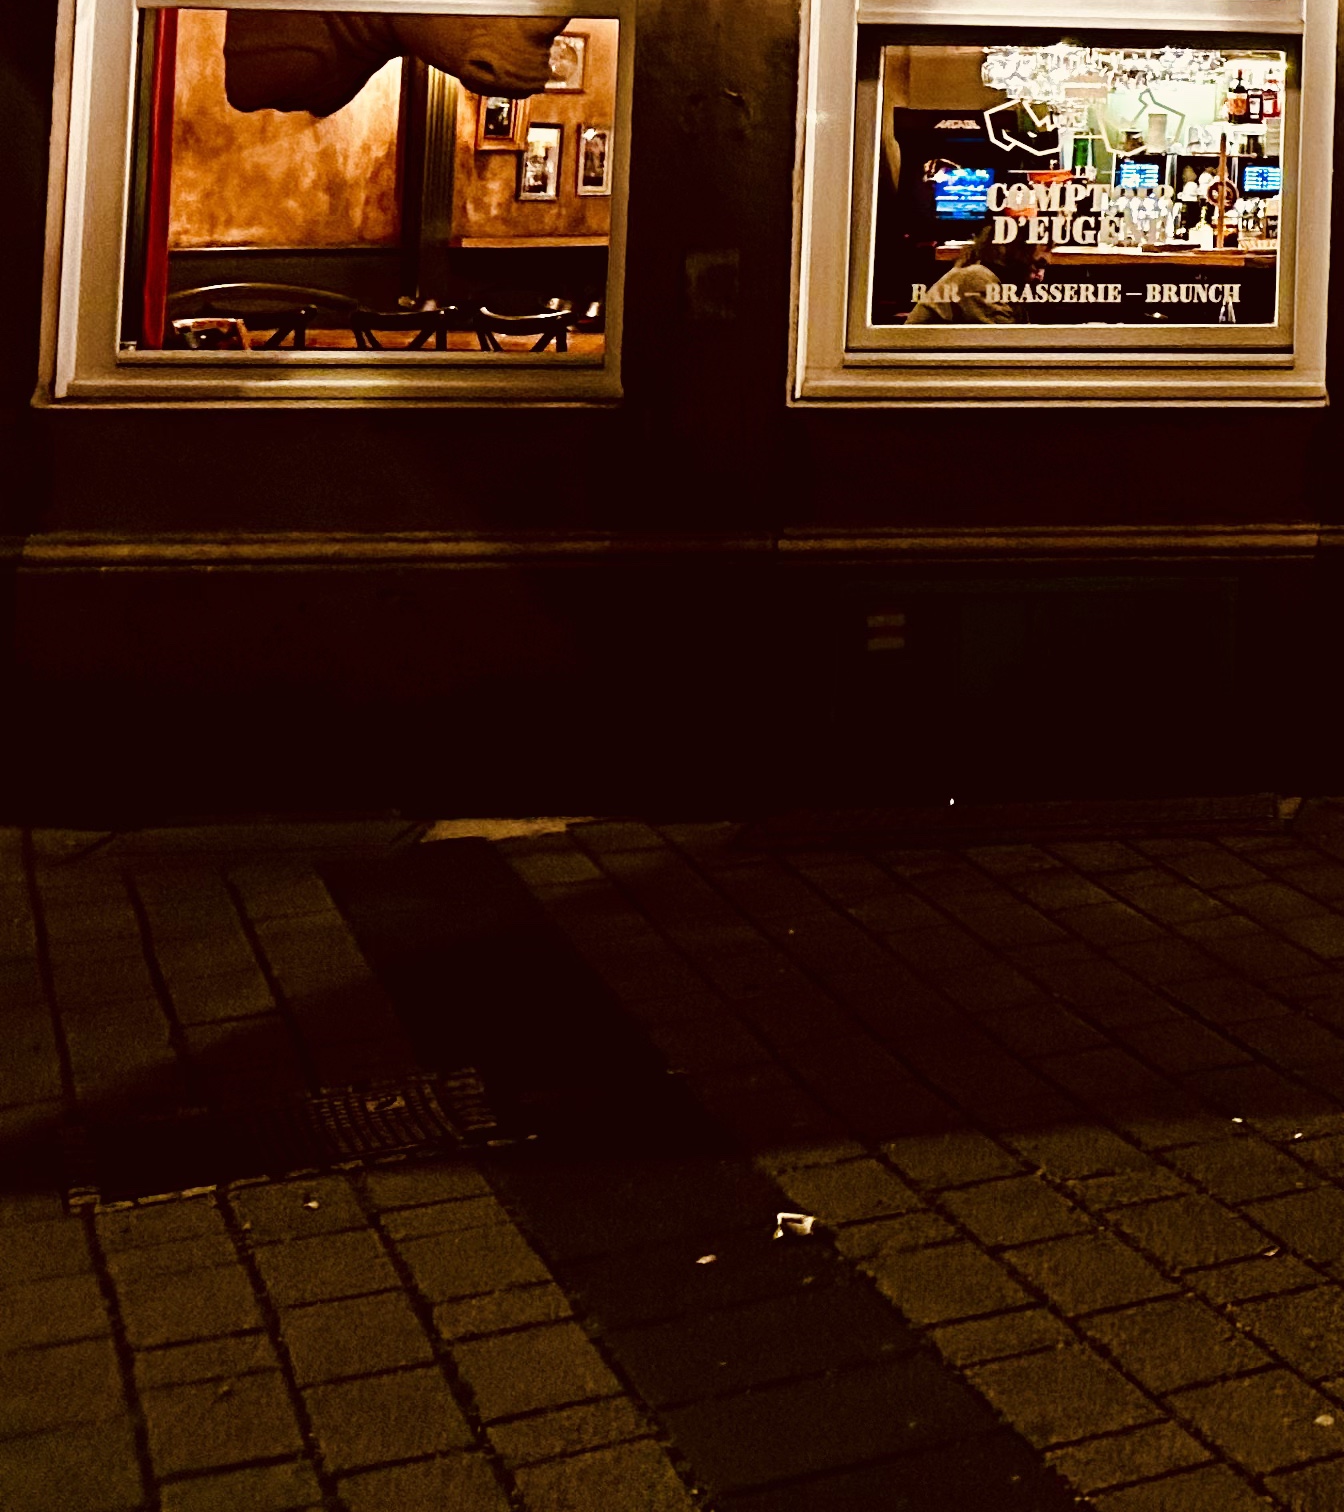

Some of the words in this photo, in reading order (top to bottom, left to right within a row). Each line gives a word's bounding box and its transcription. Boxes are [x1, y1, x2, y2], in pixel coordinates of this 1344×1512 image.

[910, 283, 960, 303] BAR
[985, 283, 1122, 303] BRASSERIE
[1144, 283, 1241, 303] BRUNCH
